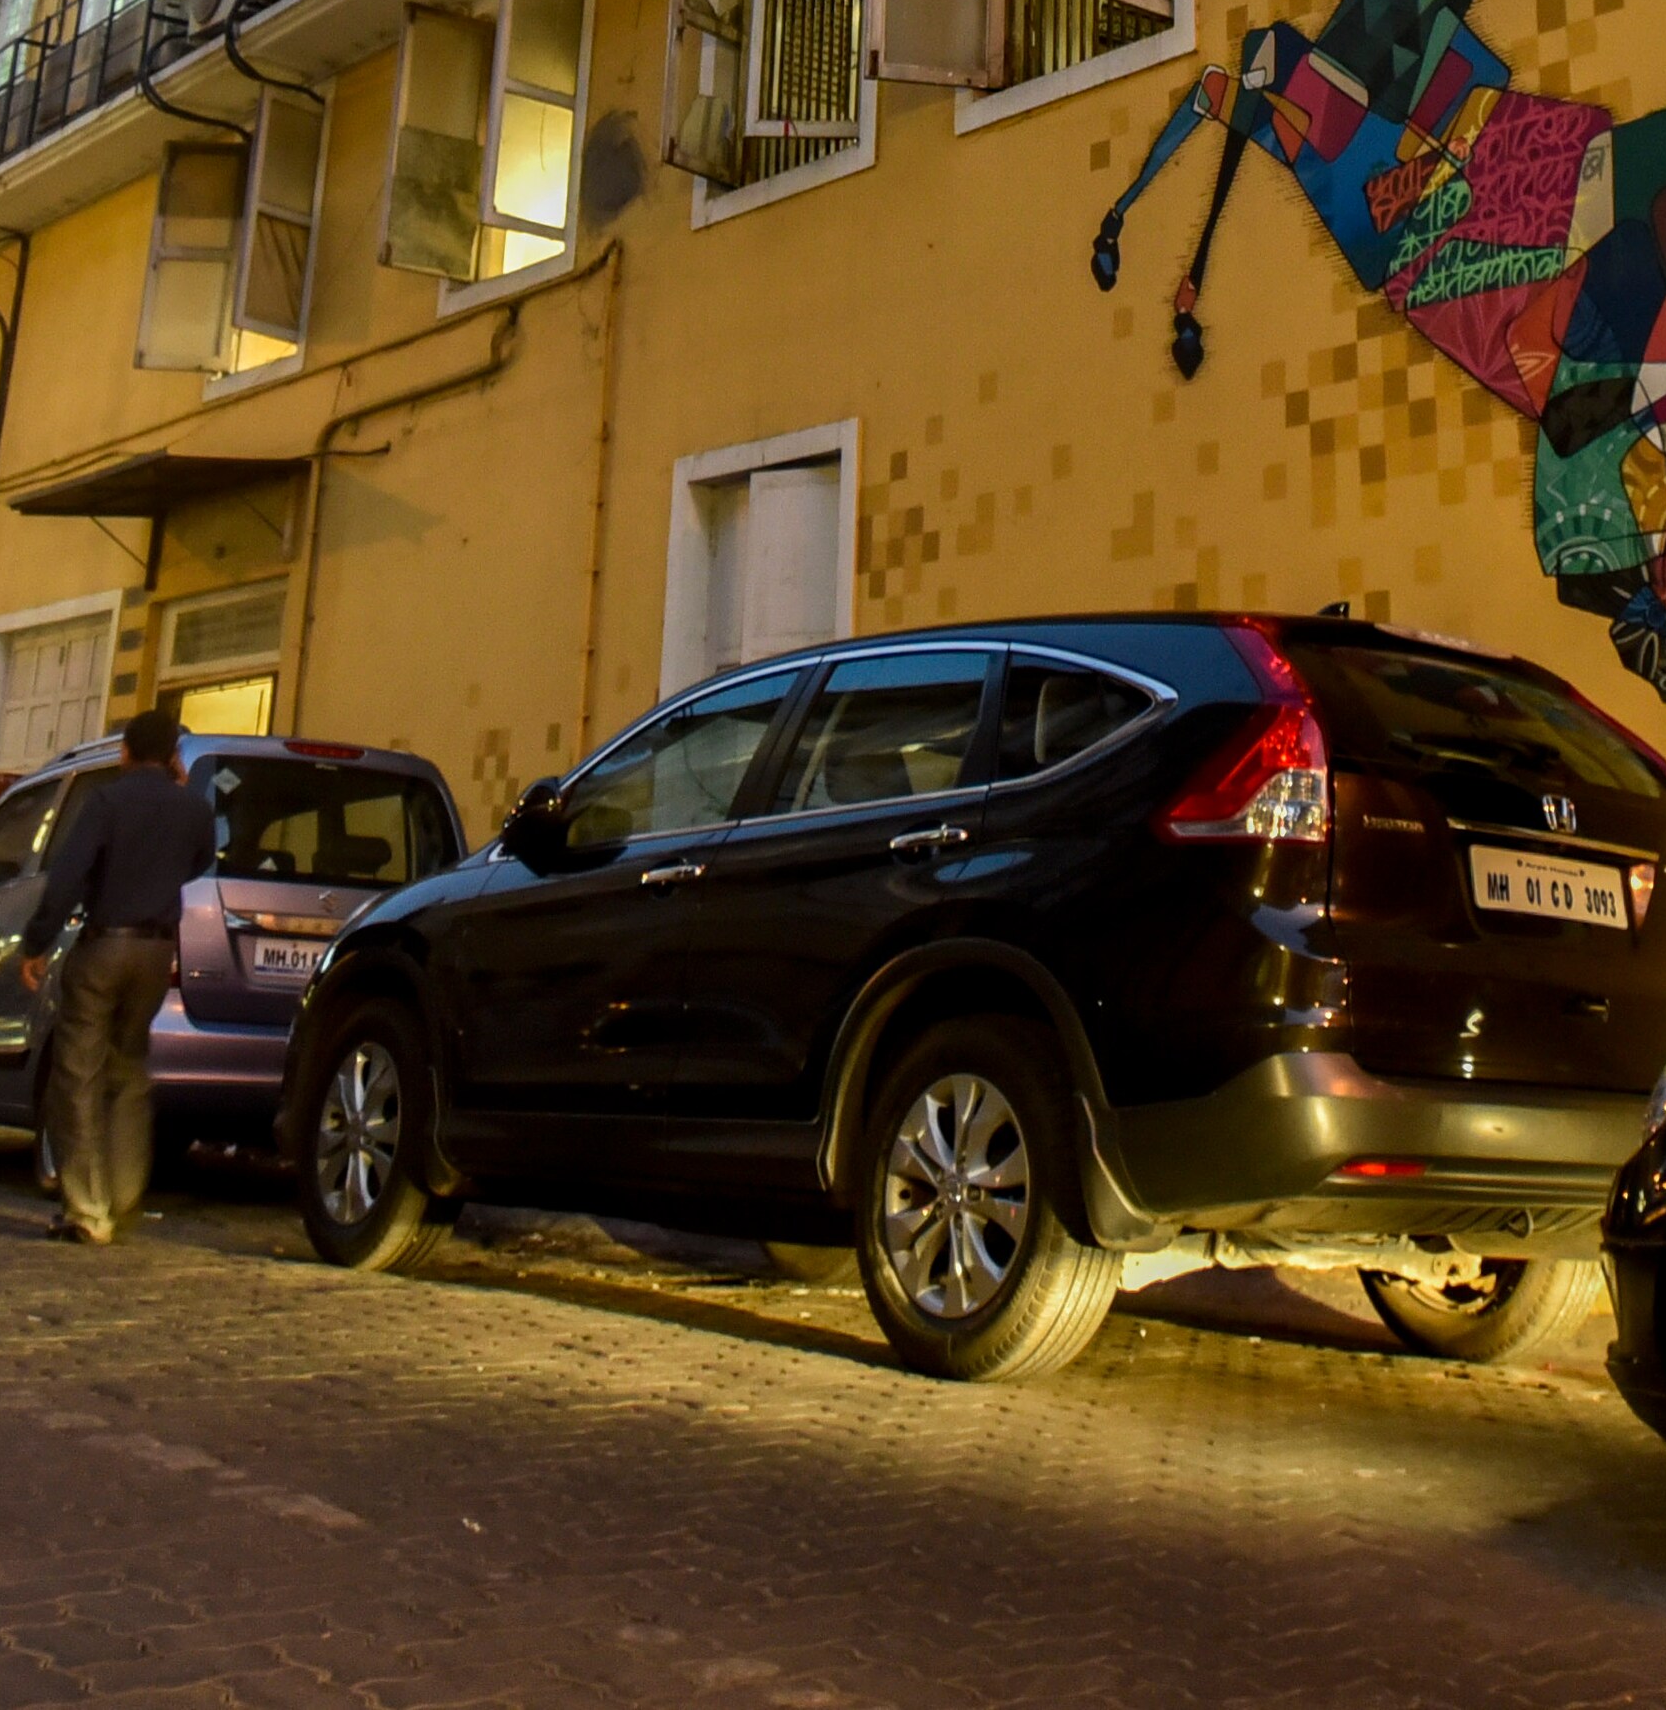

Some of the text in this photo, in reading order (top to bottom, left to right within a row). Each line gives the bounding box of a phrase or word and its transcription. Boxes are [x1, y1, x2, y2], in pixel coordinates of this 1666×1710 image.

[1487, 872, 1510, 902] MH
[1526, 877, 1541, 906] 01
[1585, 887, 1617, 919] 3093
